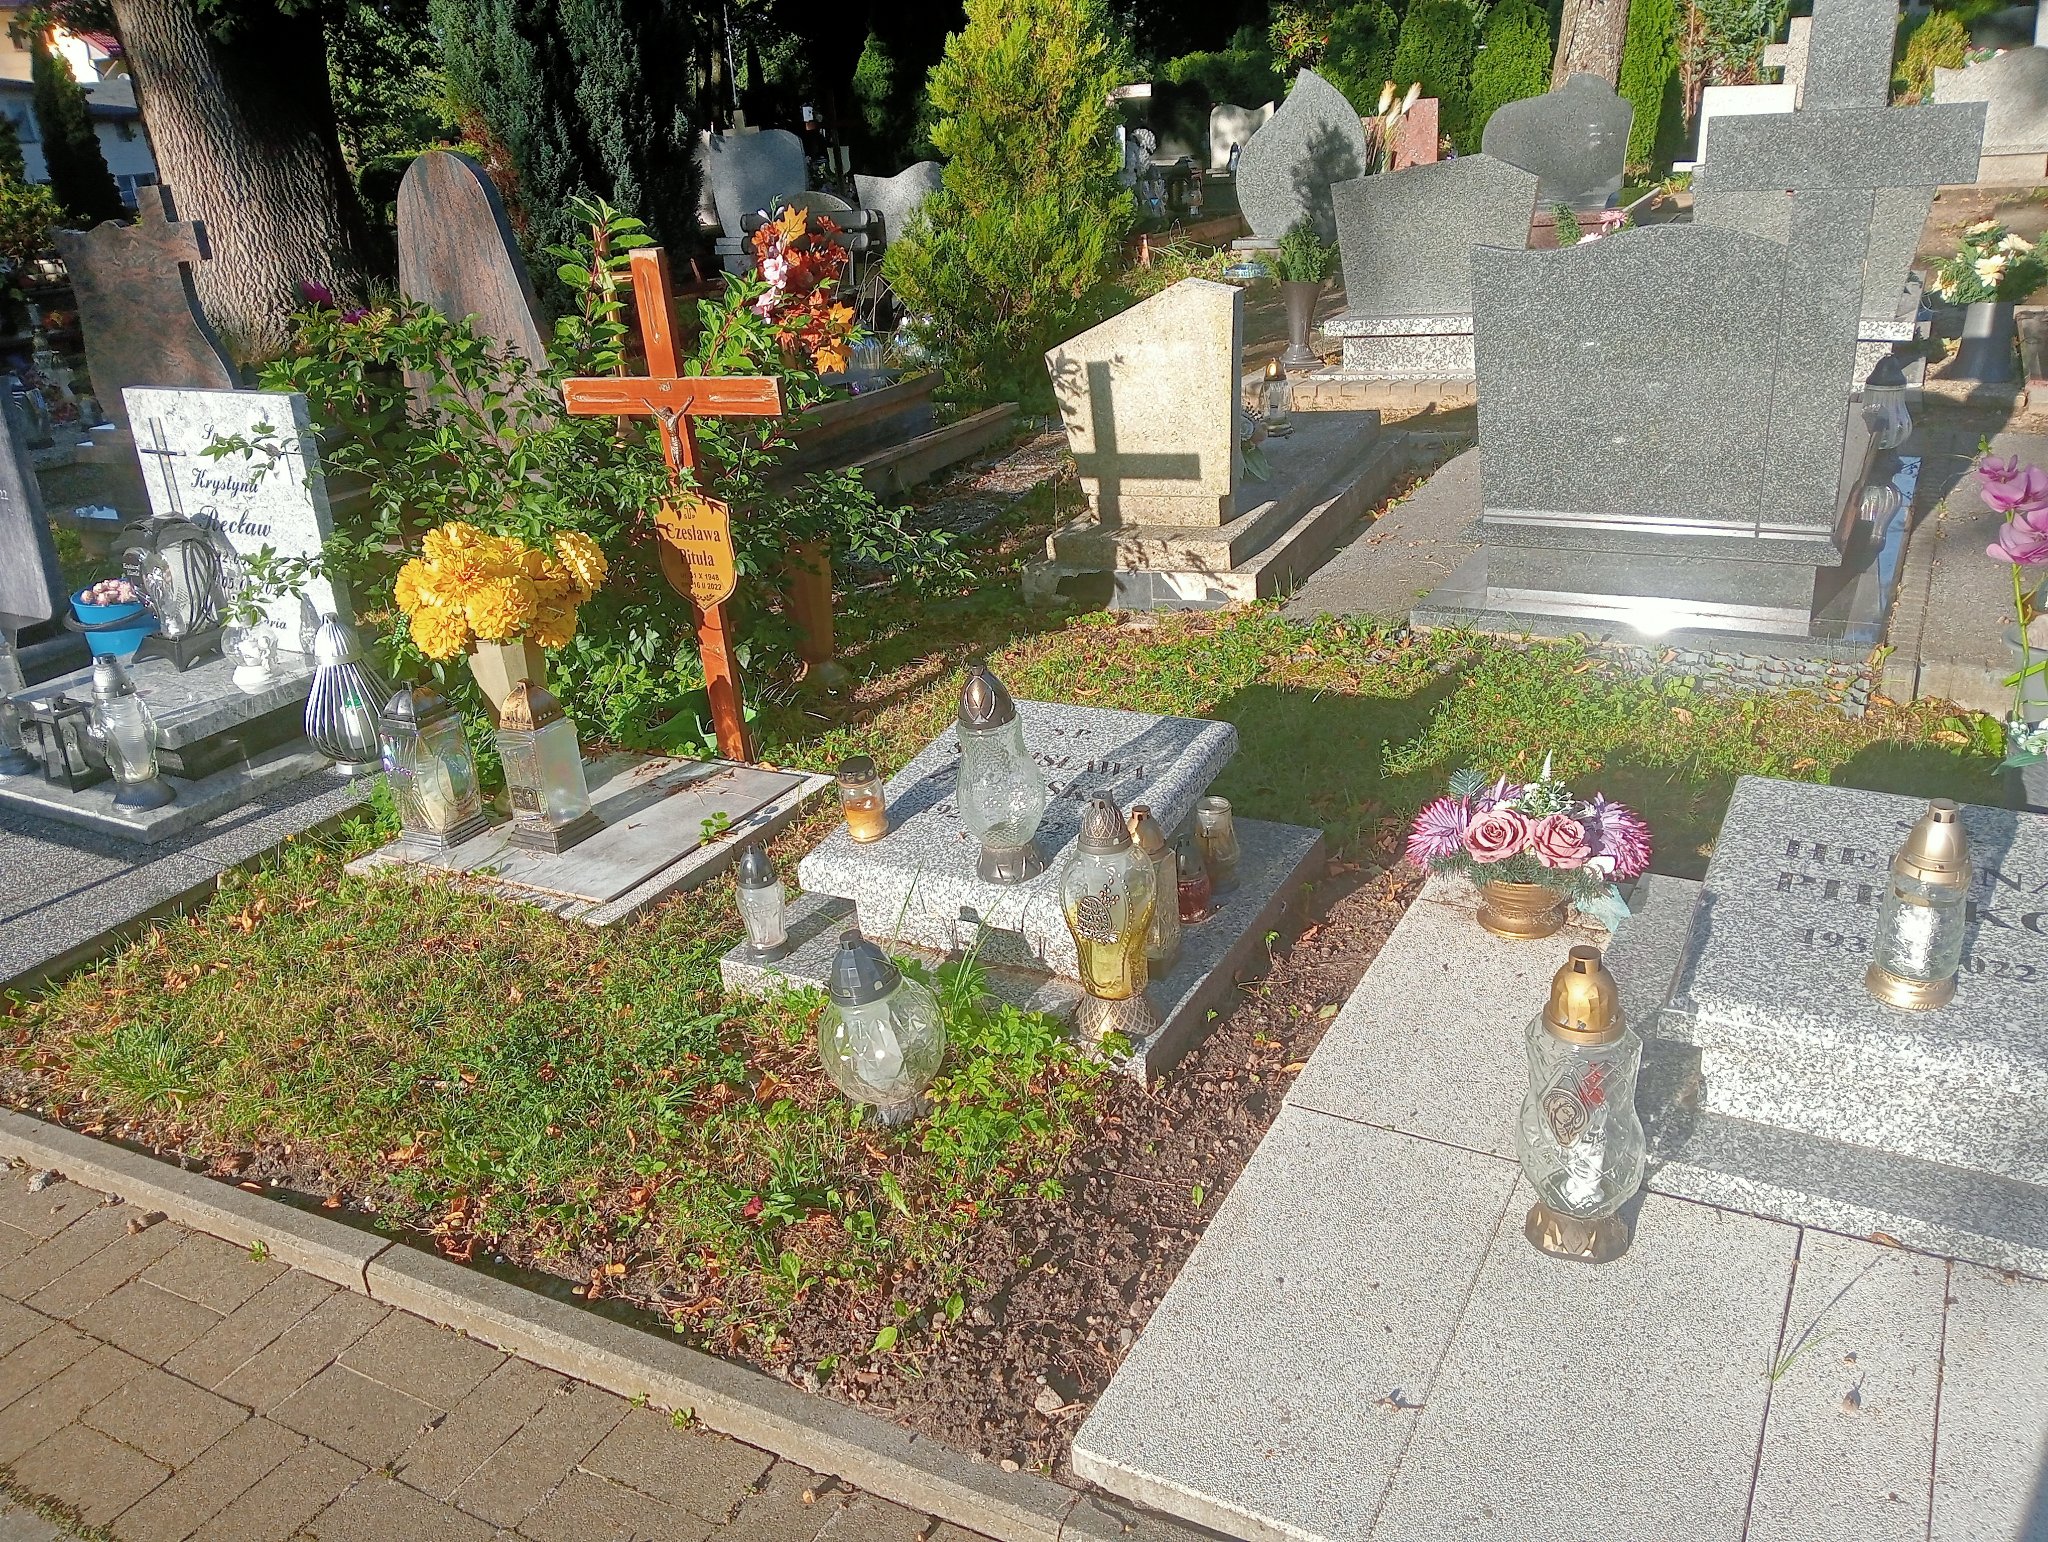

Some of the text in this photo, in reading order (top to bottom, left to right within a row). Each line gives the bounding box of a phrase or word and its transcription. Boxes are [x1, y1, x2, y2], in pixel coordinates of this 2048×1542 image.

[190, 467, 259, 498] Krystyna
[706, 583, 722, 591] 2022
[1802, 927, 2037, 984] 193 022
